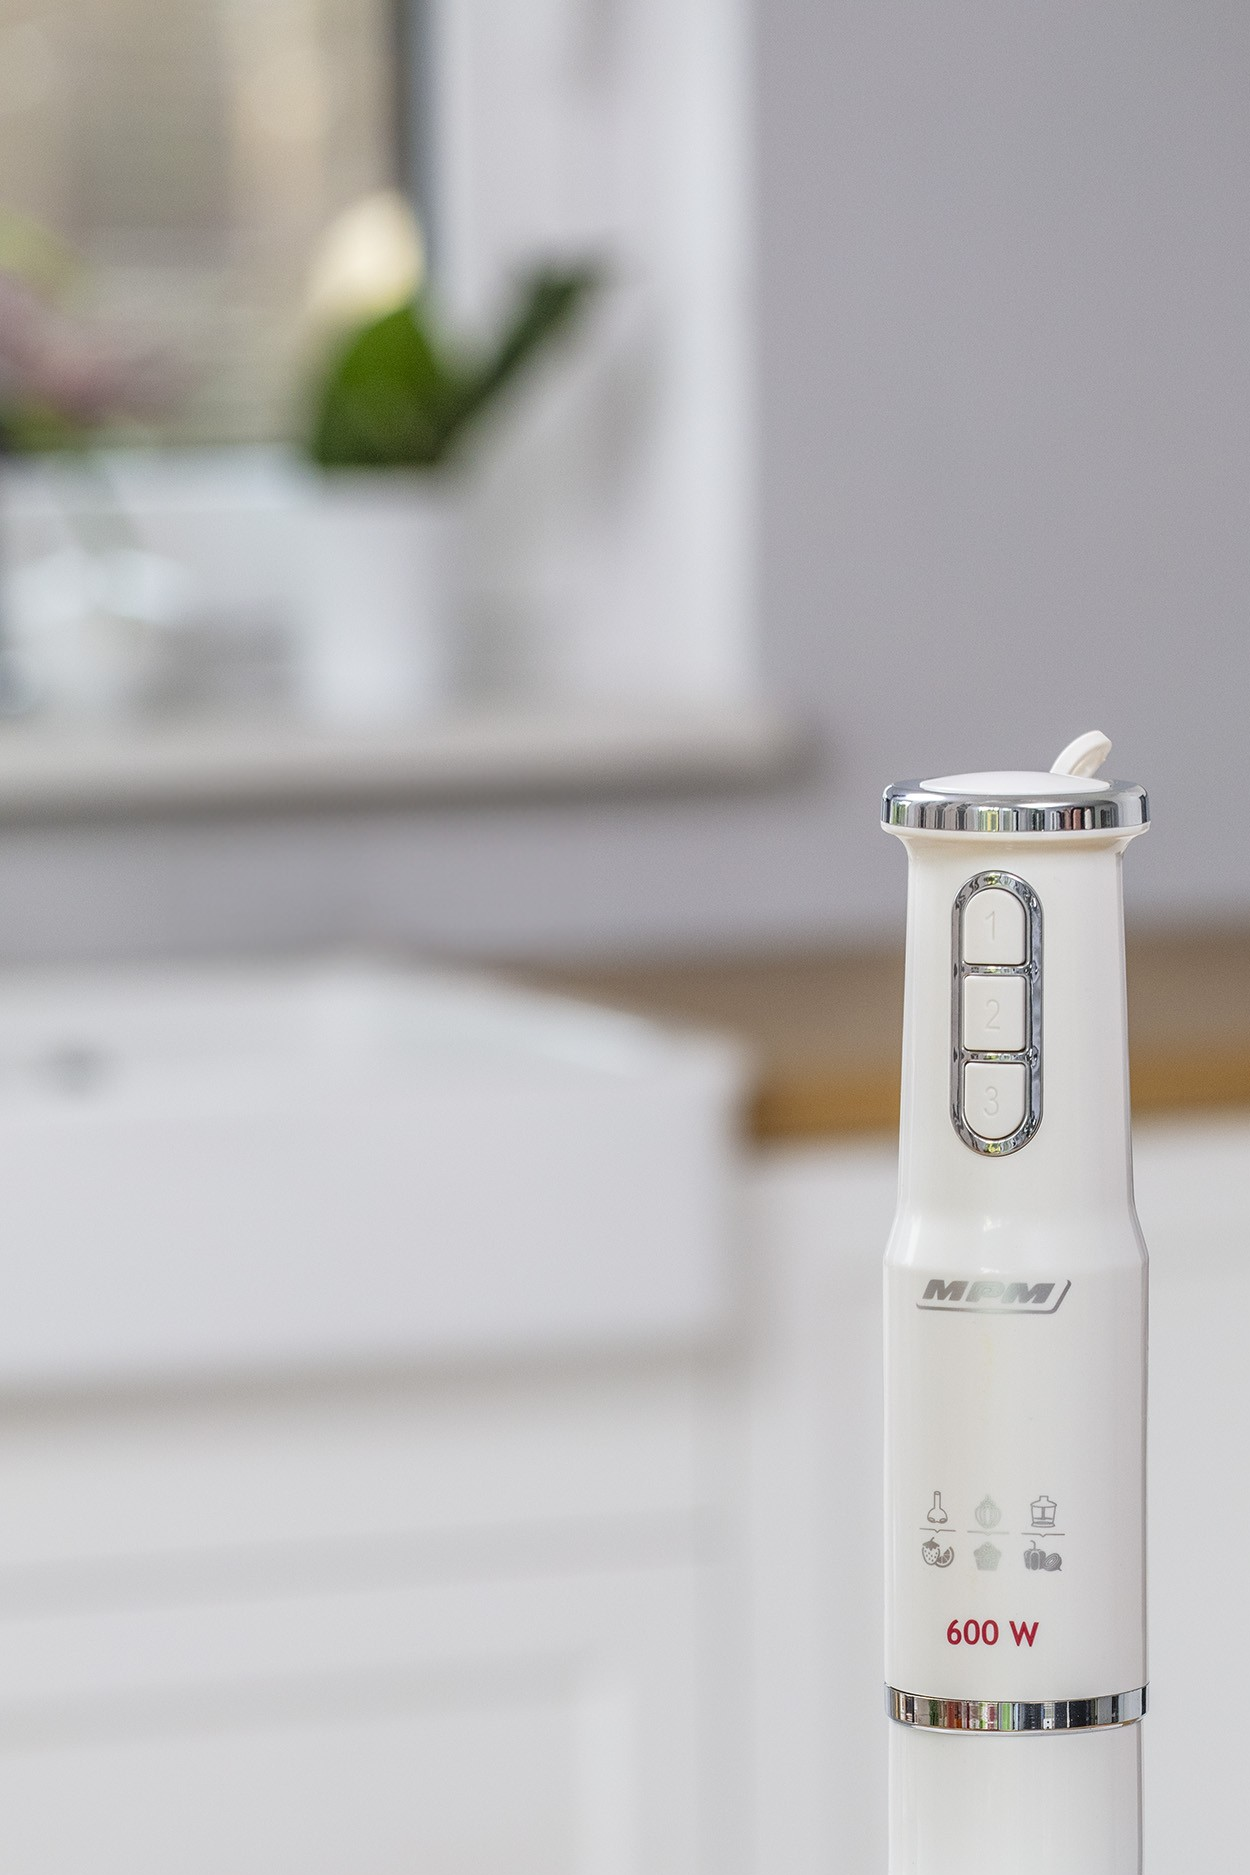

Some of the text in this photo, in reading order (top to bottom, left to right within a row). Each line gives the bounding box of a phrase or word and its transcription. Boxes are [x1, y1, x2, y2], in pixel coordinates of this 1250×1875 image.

[984, 910, 997, 941] 1
[985, 998, 1001, 1030] 2
[983, 1086, 1000, 1117] 3
[922, 1279, 1056, 1304] MPM
[947, 1619, 1039, 1647] 600 W
